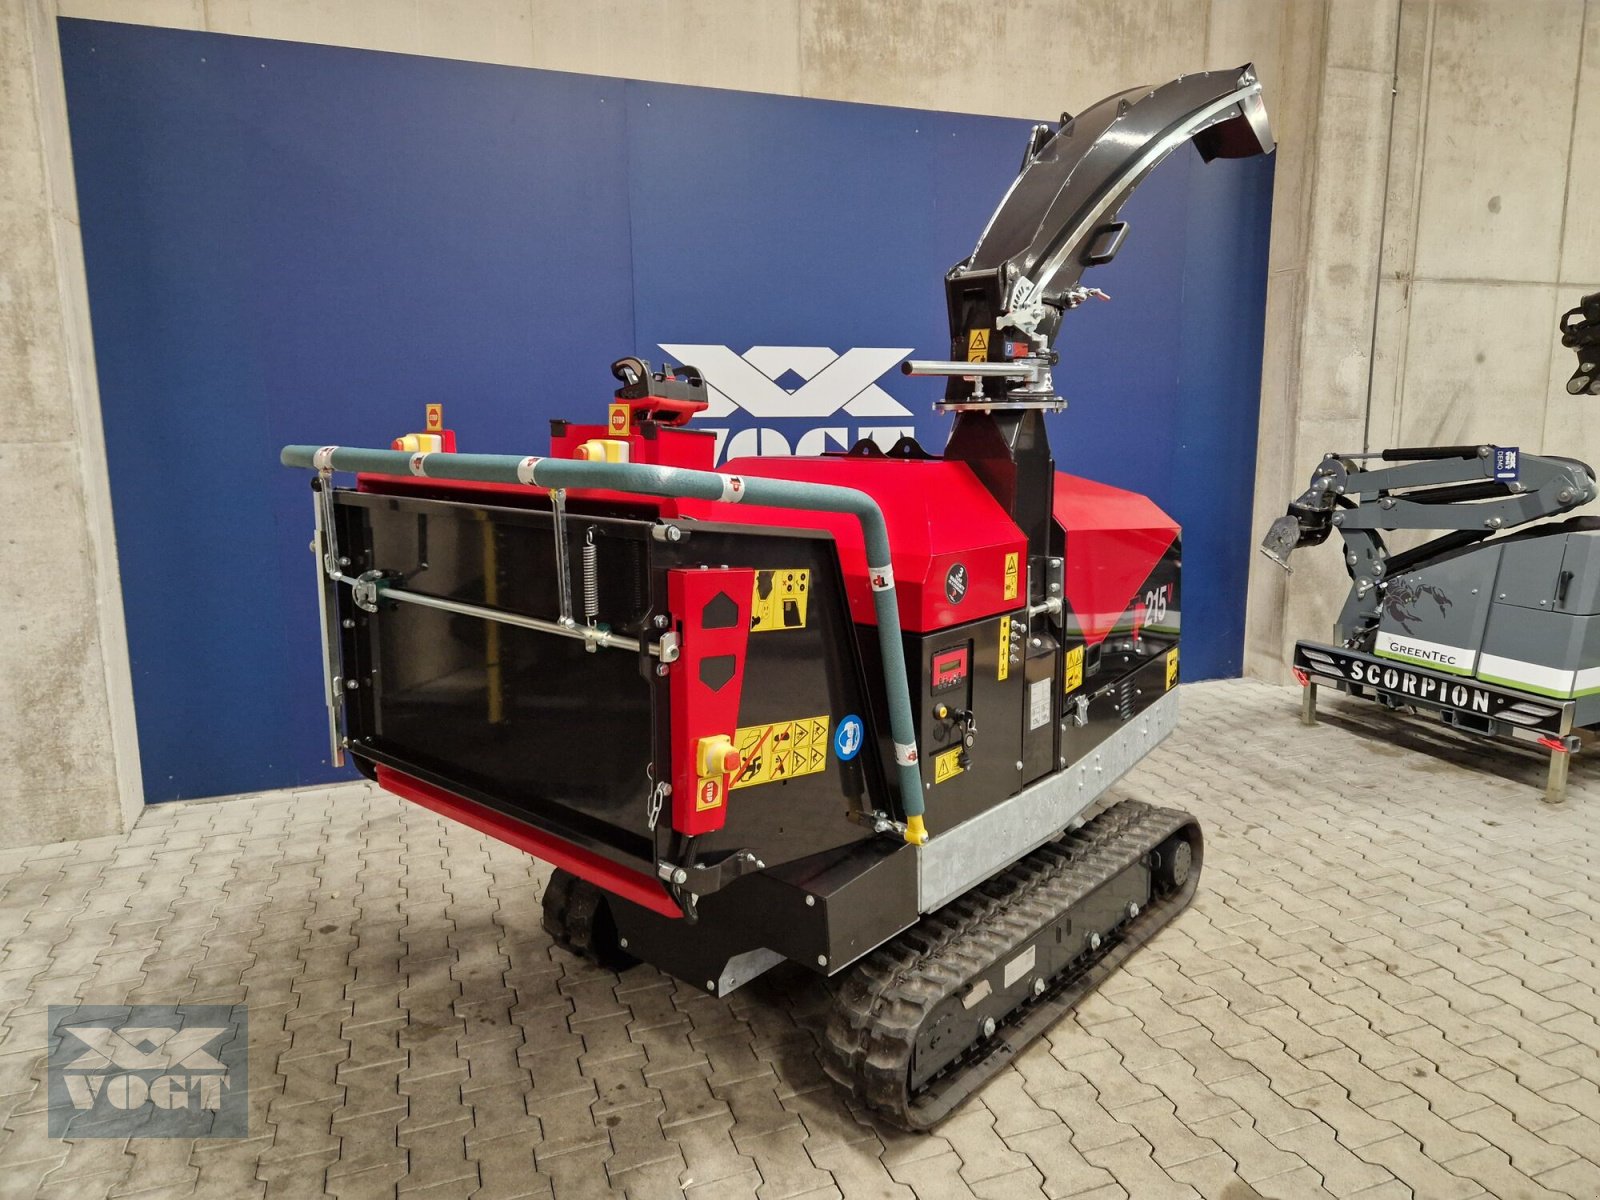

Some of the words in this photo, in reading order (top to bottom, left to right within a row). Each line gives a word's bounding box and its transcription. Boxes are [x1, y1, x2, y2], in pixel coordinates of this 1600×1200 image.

[612, 416, 625, 424] STOP
[1350, 660, 1490, 713] SCORPION
[706, 782, 714, 802] STOP
